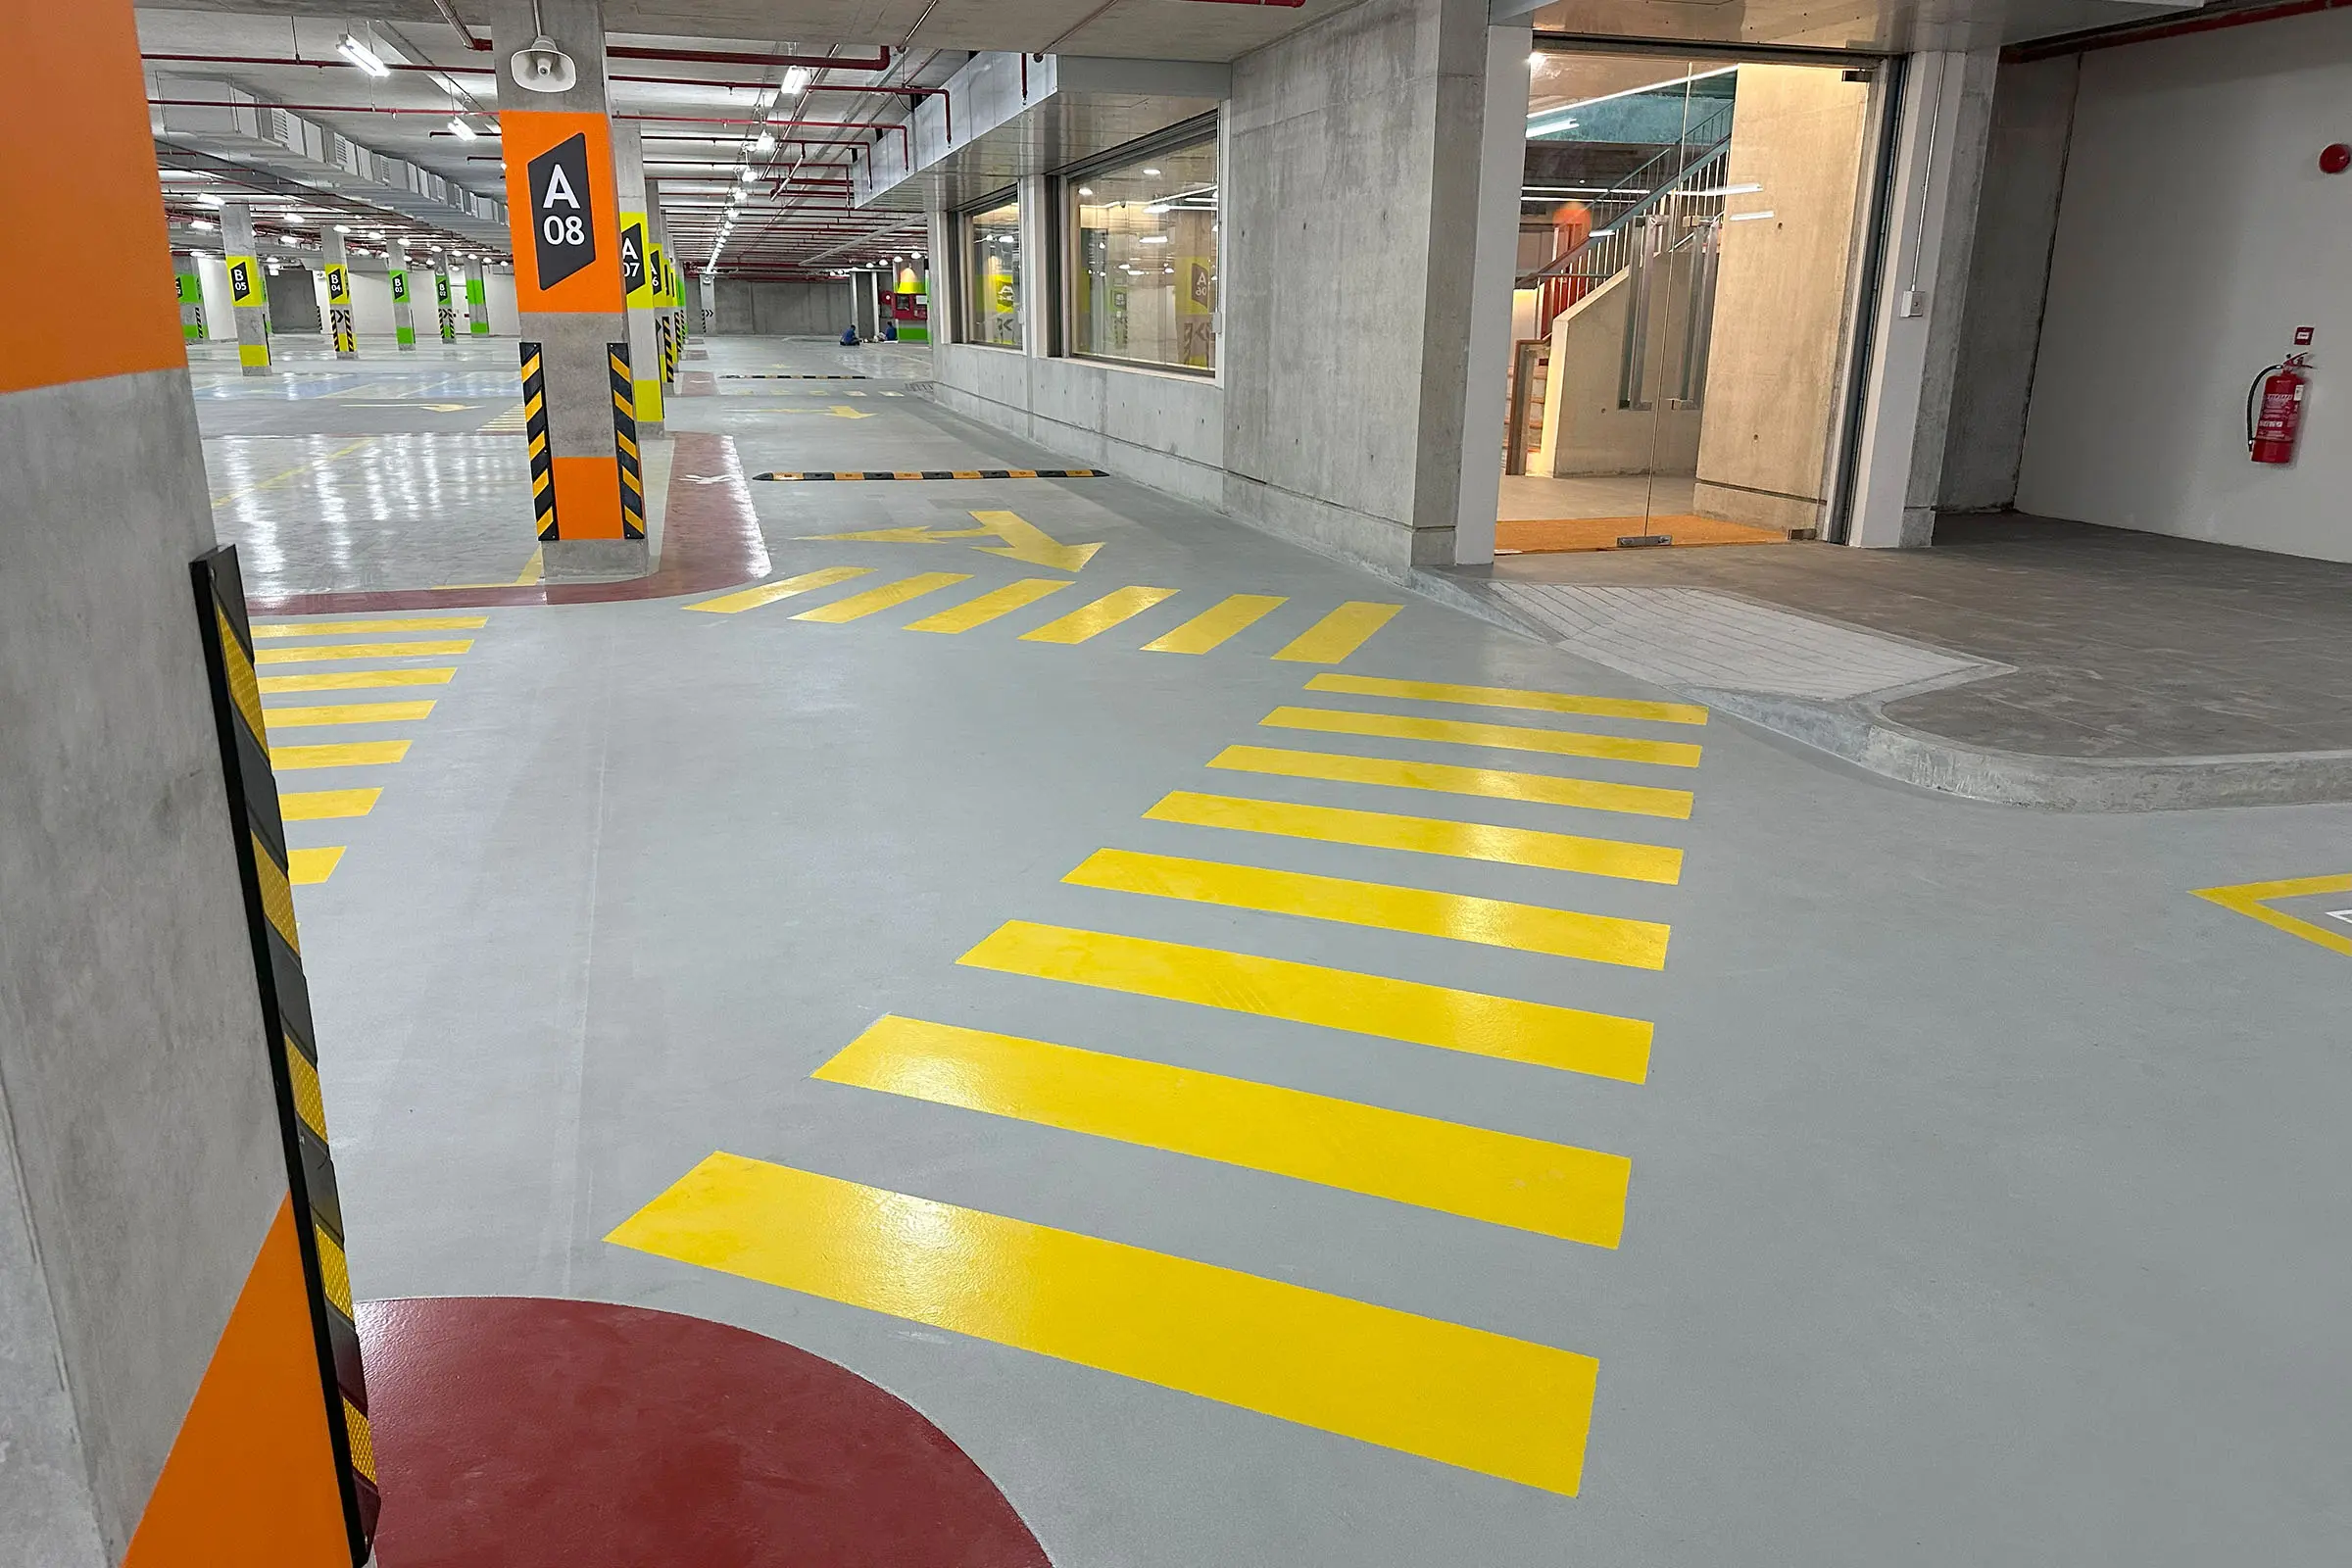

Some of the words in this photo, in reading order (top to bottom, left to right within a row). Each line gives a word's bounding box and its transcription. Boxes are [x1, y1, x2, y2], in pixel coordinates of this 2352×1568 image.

[543, 164, 581, 209] A
[543, 215, 585, 246] 08
[622, 237, 639, 260] A
[233, 269, 244, 281] B
[330, 273, 339, 284] B
[652, 276, 659, 286] 6
[234, 281, 247, 291] 05
